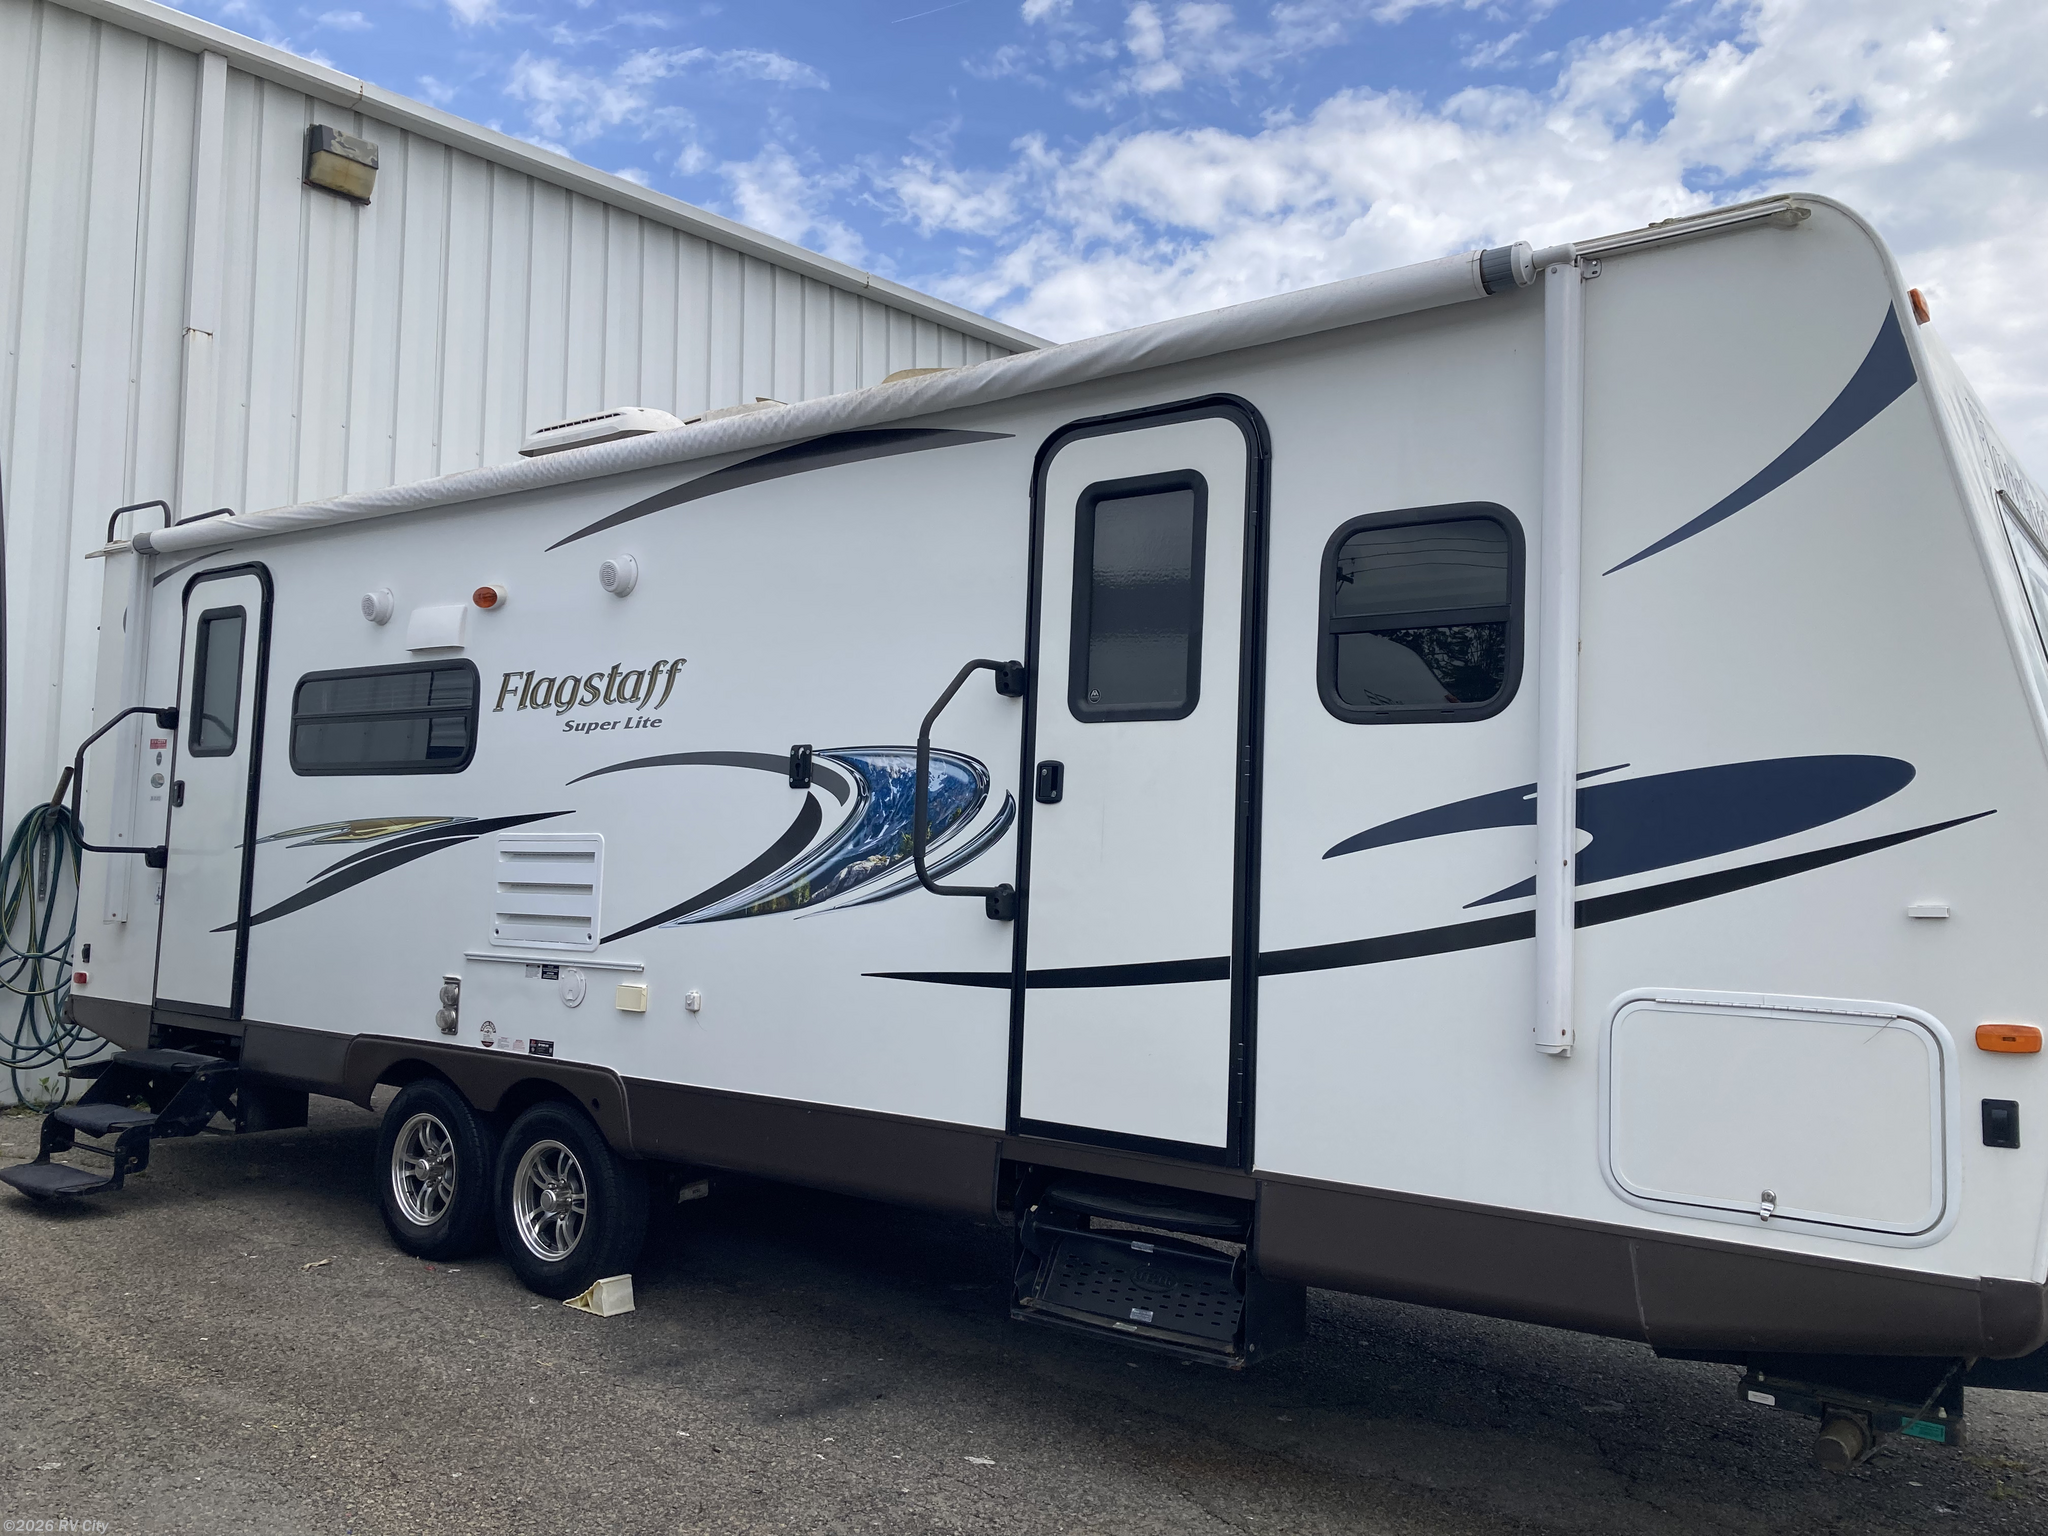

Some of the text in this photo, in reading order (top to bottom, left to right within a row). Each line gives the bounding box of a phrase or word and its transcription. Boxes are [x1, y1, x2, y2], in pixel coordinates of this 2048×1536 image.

[492, 657, 688, 716] Flagstaff
[562, 716, 663, 735] Super Lite
